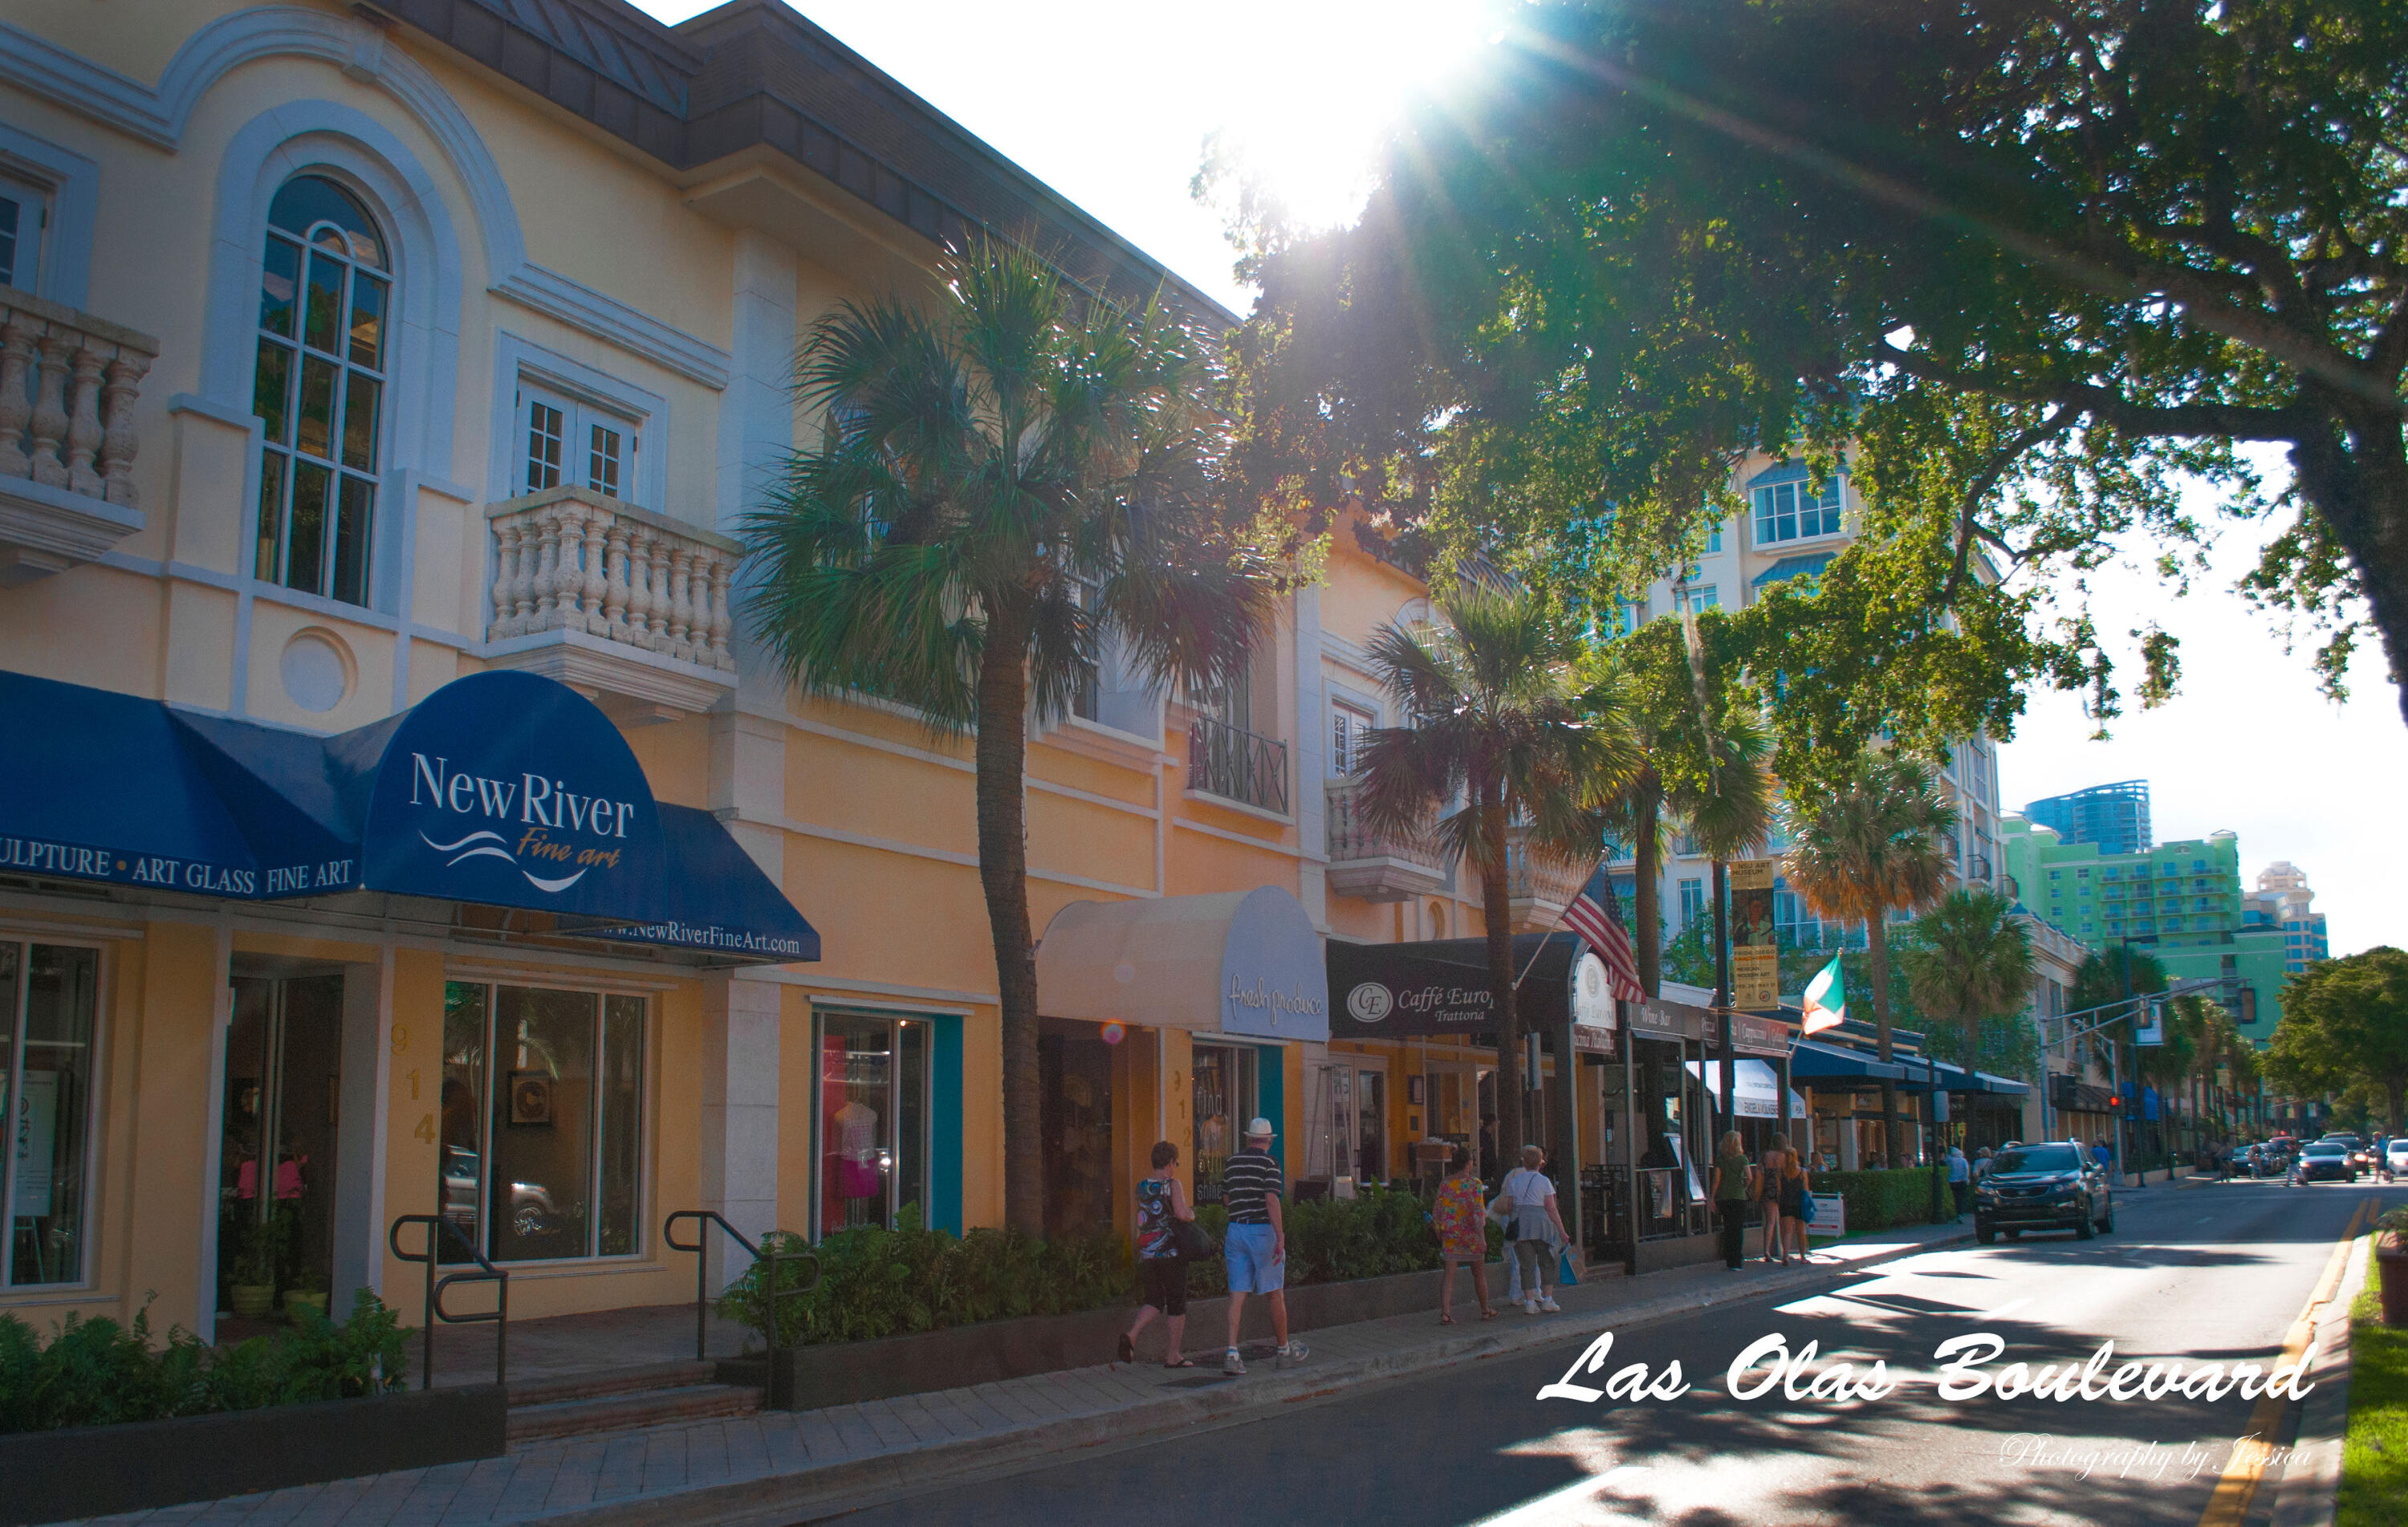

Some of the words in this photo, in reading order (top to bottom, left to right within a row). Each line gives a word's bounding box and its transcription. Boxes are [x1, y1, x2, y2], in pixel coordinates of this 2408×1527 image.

[410, 751, 517, 819] New
[521, 773, 635, 838] River
[517, 828, 573, 861] Fine
[577, 848, 621, 869] art
[132, 857, 181, 885] ART
[186, 863, 255, 894] GLASS
[267, 865, 309, 893] FINE
[314, 859, 354, 887] ART
[602, 921, 800, 953] .NewRiverFineArt.com
[1228, 973, 1271, 1020] fresh
[1270, 979, 1323, 1025] produce
[1398, 986, 1444, 1012] Caffé
[1446, 987, 1495, 1009] Euro
[1434, 1008, 1485, 1022] Trattoria
[1641, 1005, 1658, 1025] Wine
[1659, 1009, 1672, 1027] Bar
